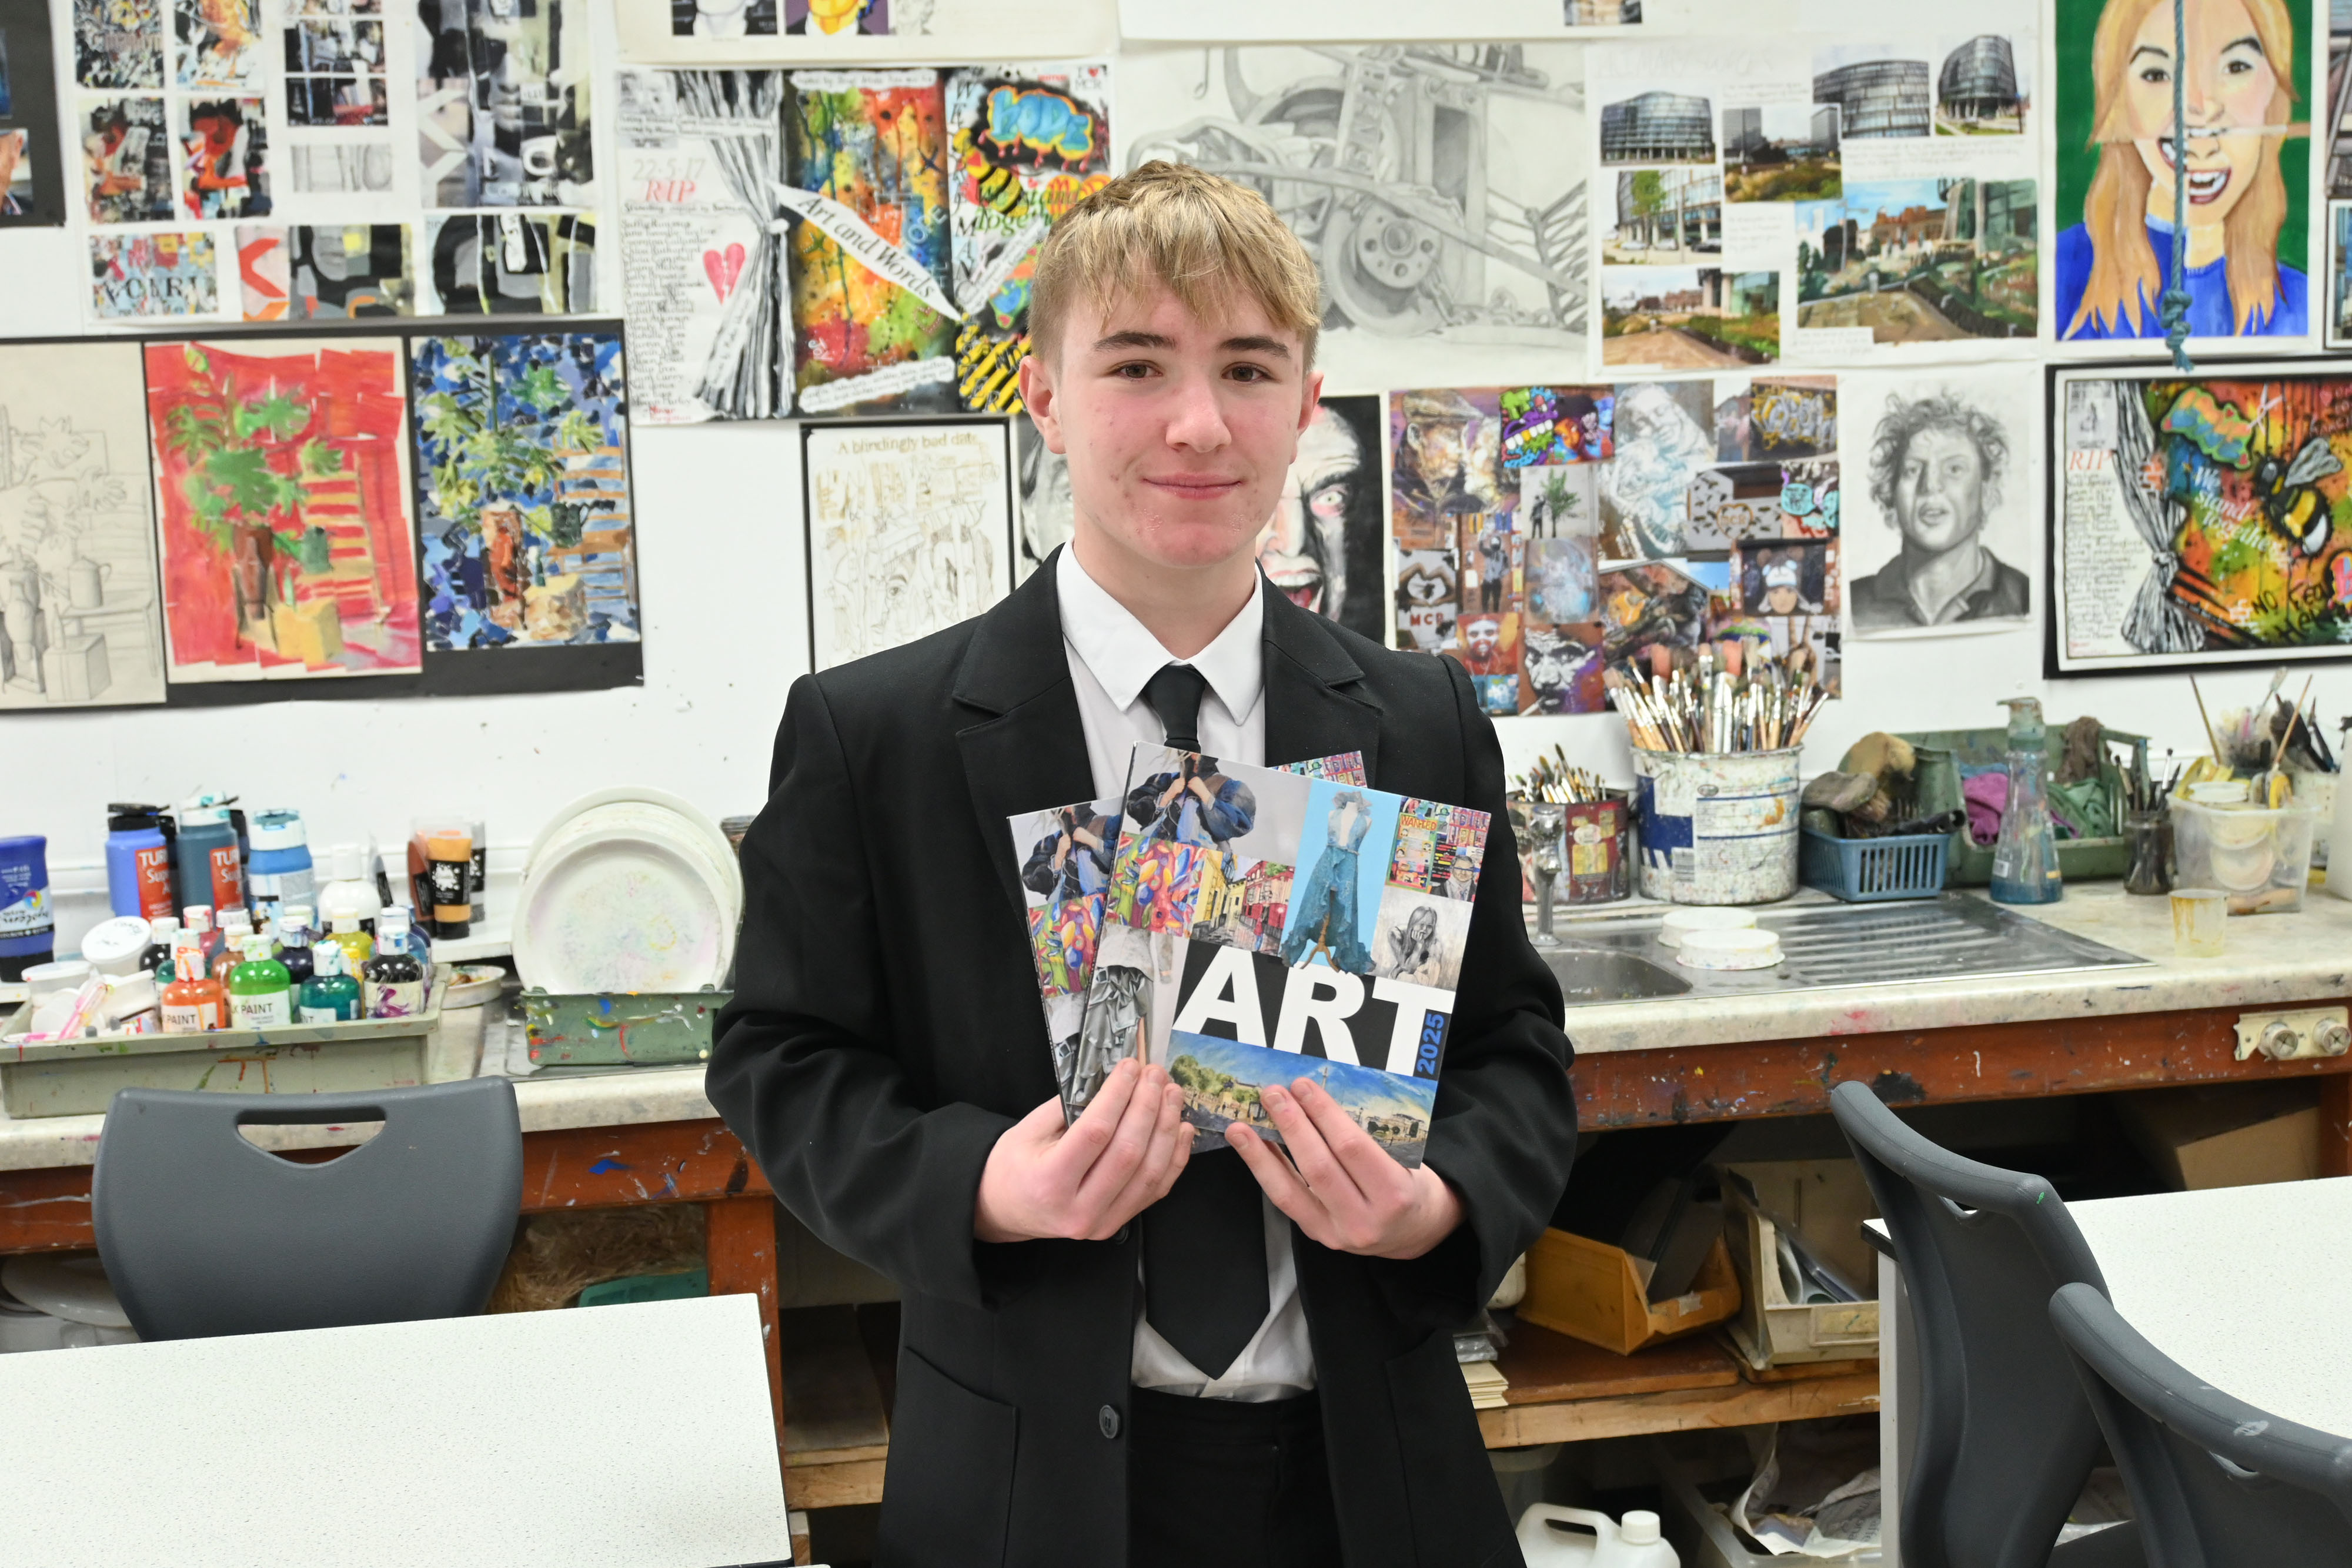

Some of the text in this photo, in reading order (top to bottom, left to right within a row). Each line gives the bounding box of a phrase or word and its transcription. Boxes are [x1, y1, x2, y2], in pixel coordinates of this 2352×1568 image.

[646, 179, 697, 203] RIP
[798, 196, 934, 298] Art and Words
[838, 442, 849, 454] A
[921, 432, 947, 449] bad
[2070, 450, 2114, 470] RIP
[1400, 815, 1438, 831] WANTED
[166, 1013, 196, 1025] PAINT
[241, 1002, 273, 1014] PAINT
[1172, 945, 1456, 1076] ART
[1416, 1012, 1446, 1075] 2025
